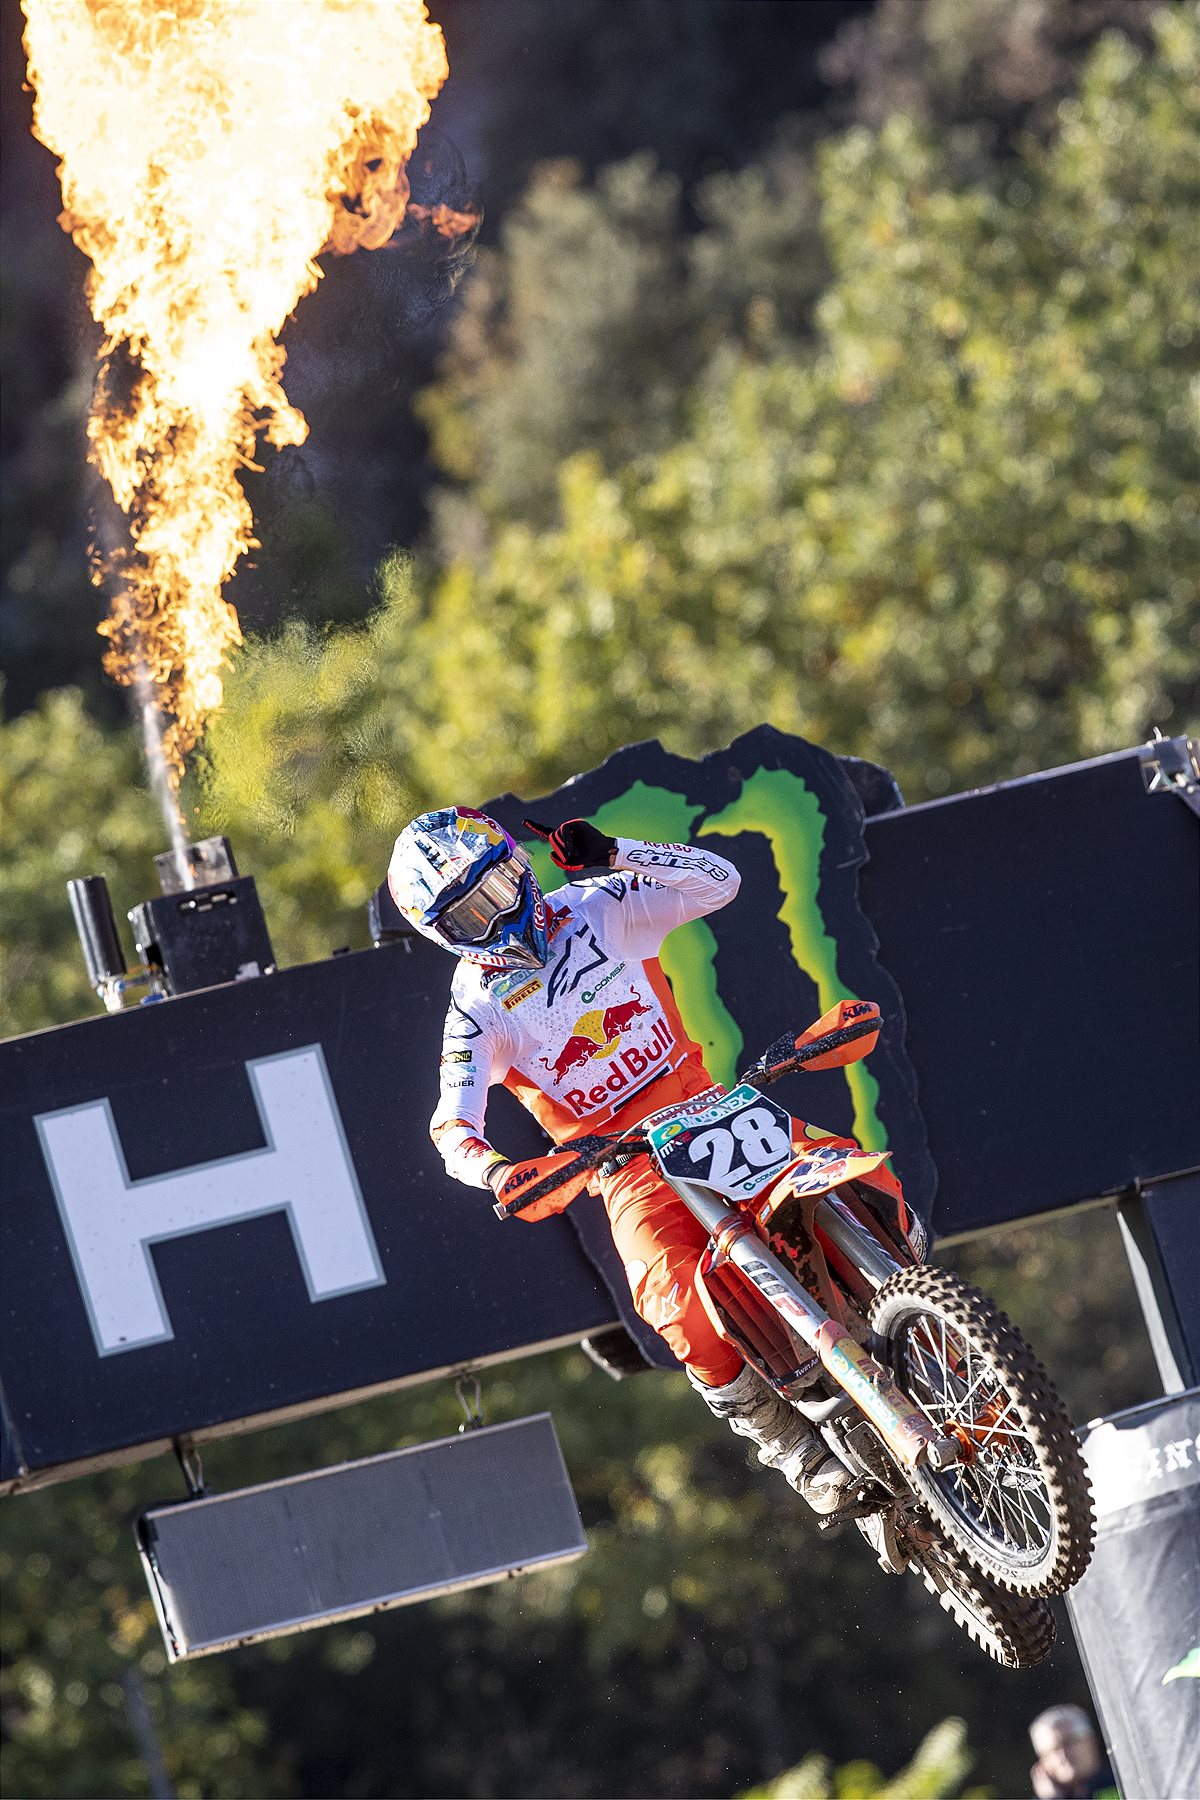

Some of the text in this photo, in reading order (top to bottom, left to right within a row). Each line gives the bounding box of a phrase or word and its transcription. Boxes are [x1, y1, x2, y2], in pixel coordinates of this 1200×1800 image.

[595, 962, 625, 992] COMISA
[503, 980, 542, 1010] PIRELLI
[843, 1003, 872, 1021] KTM
[563, 1017, 674, 1117] Red Bull
[688, 1107, 790, 1187] 28
[505, 1167, 539, 1195] KTM
[33, 1042, 388, 1358] H
